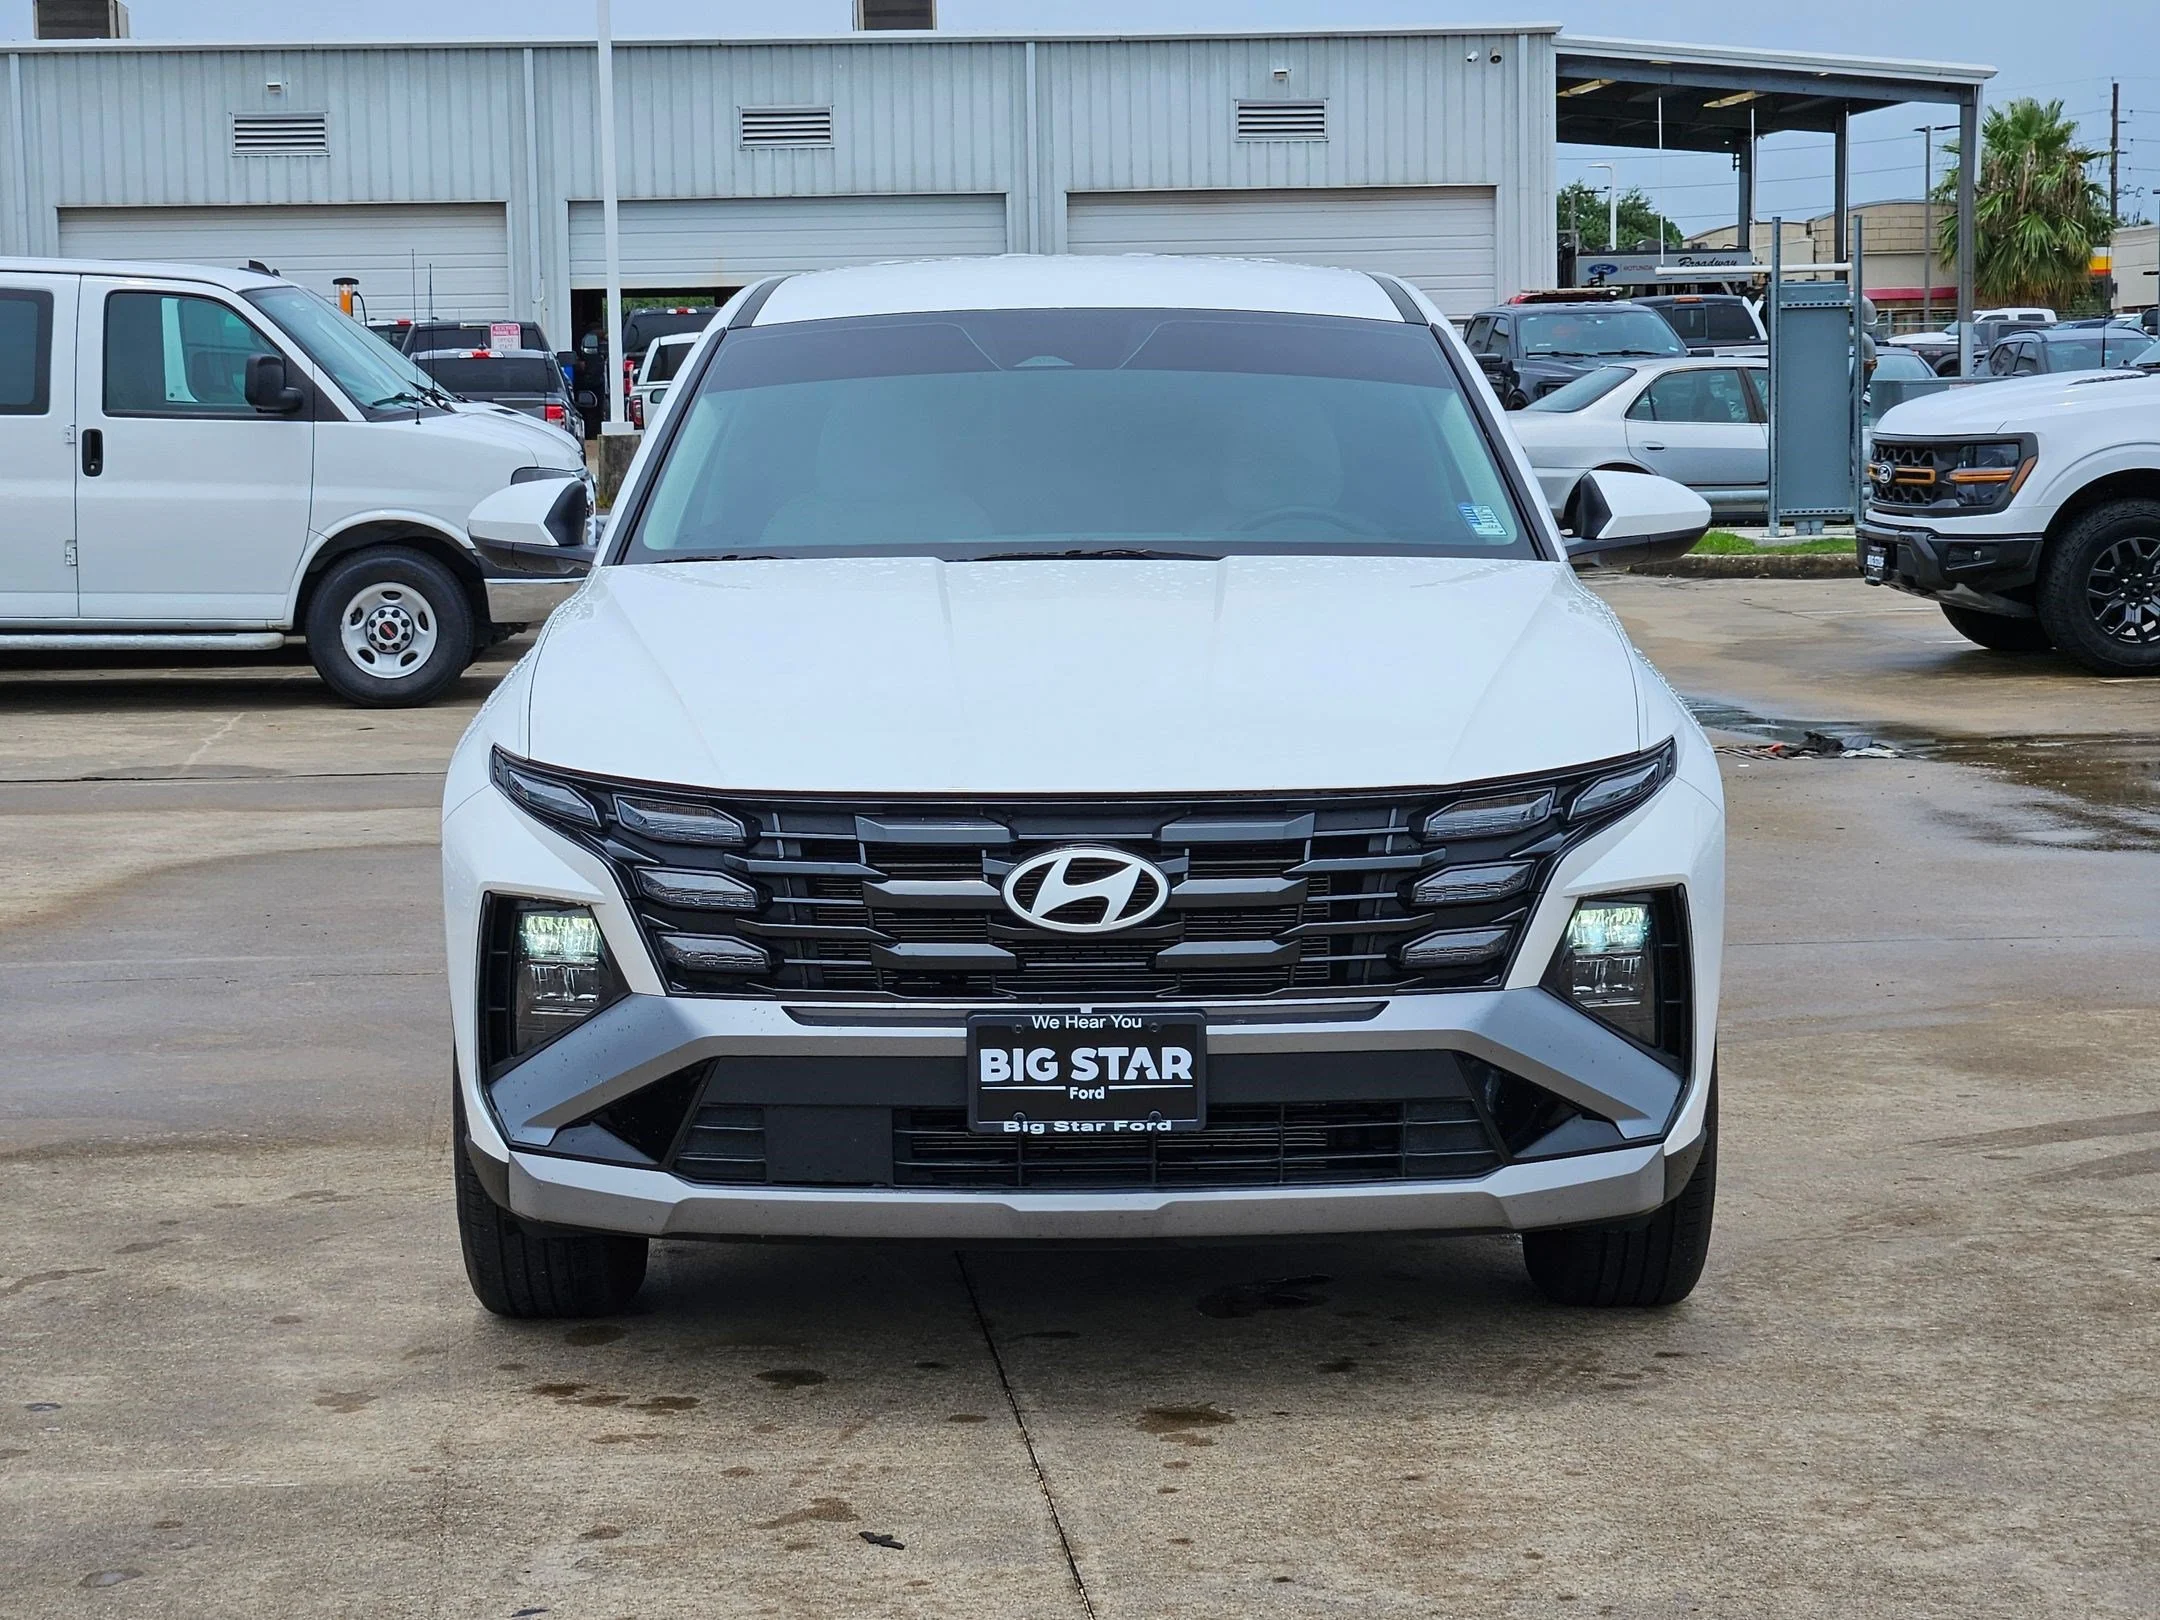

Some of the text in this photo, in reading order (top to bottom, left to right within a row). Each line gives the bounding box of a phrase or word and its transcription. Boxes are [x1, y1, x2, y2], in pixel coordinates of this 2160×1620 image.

[1678, 256, 1737, 267] Broadway
[1031, 1014, 1142, 1029] We Hear You
[980, 1046, 1193, 1082] BIG STAR
[1069, 1086, 1105, 1100] Ford
[1003, 1119, 1172, 1134] Big Star Ford
